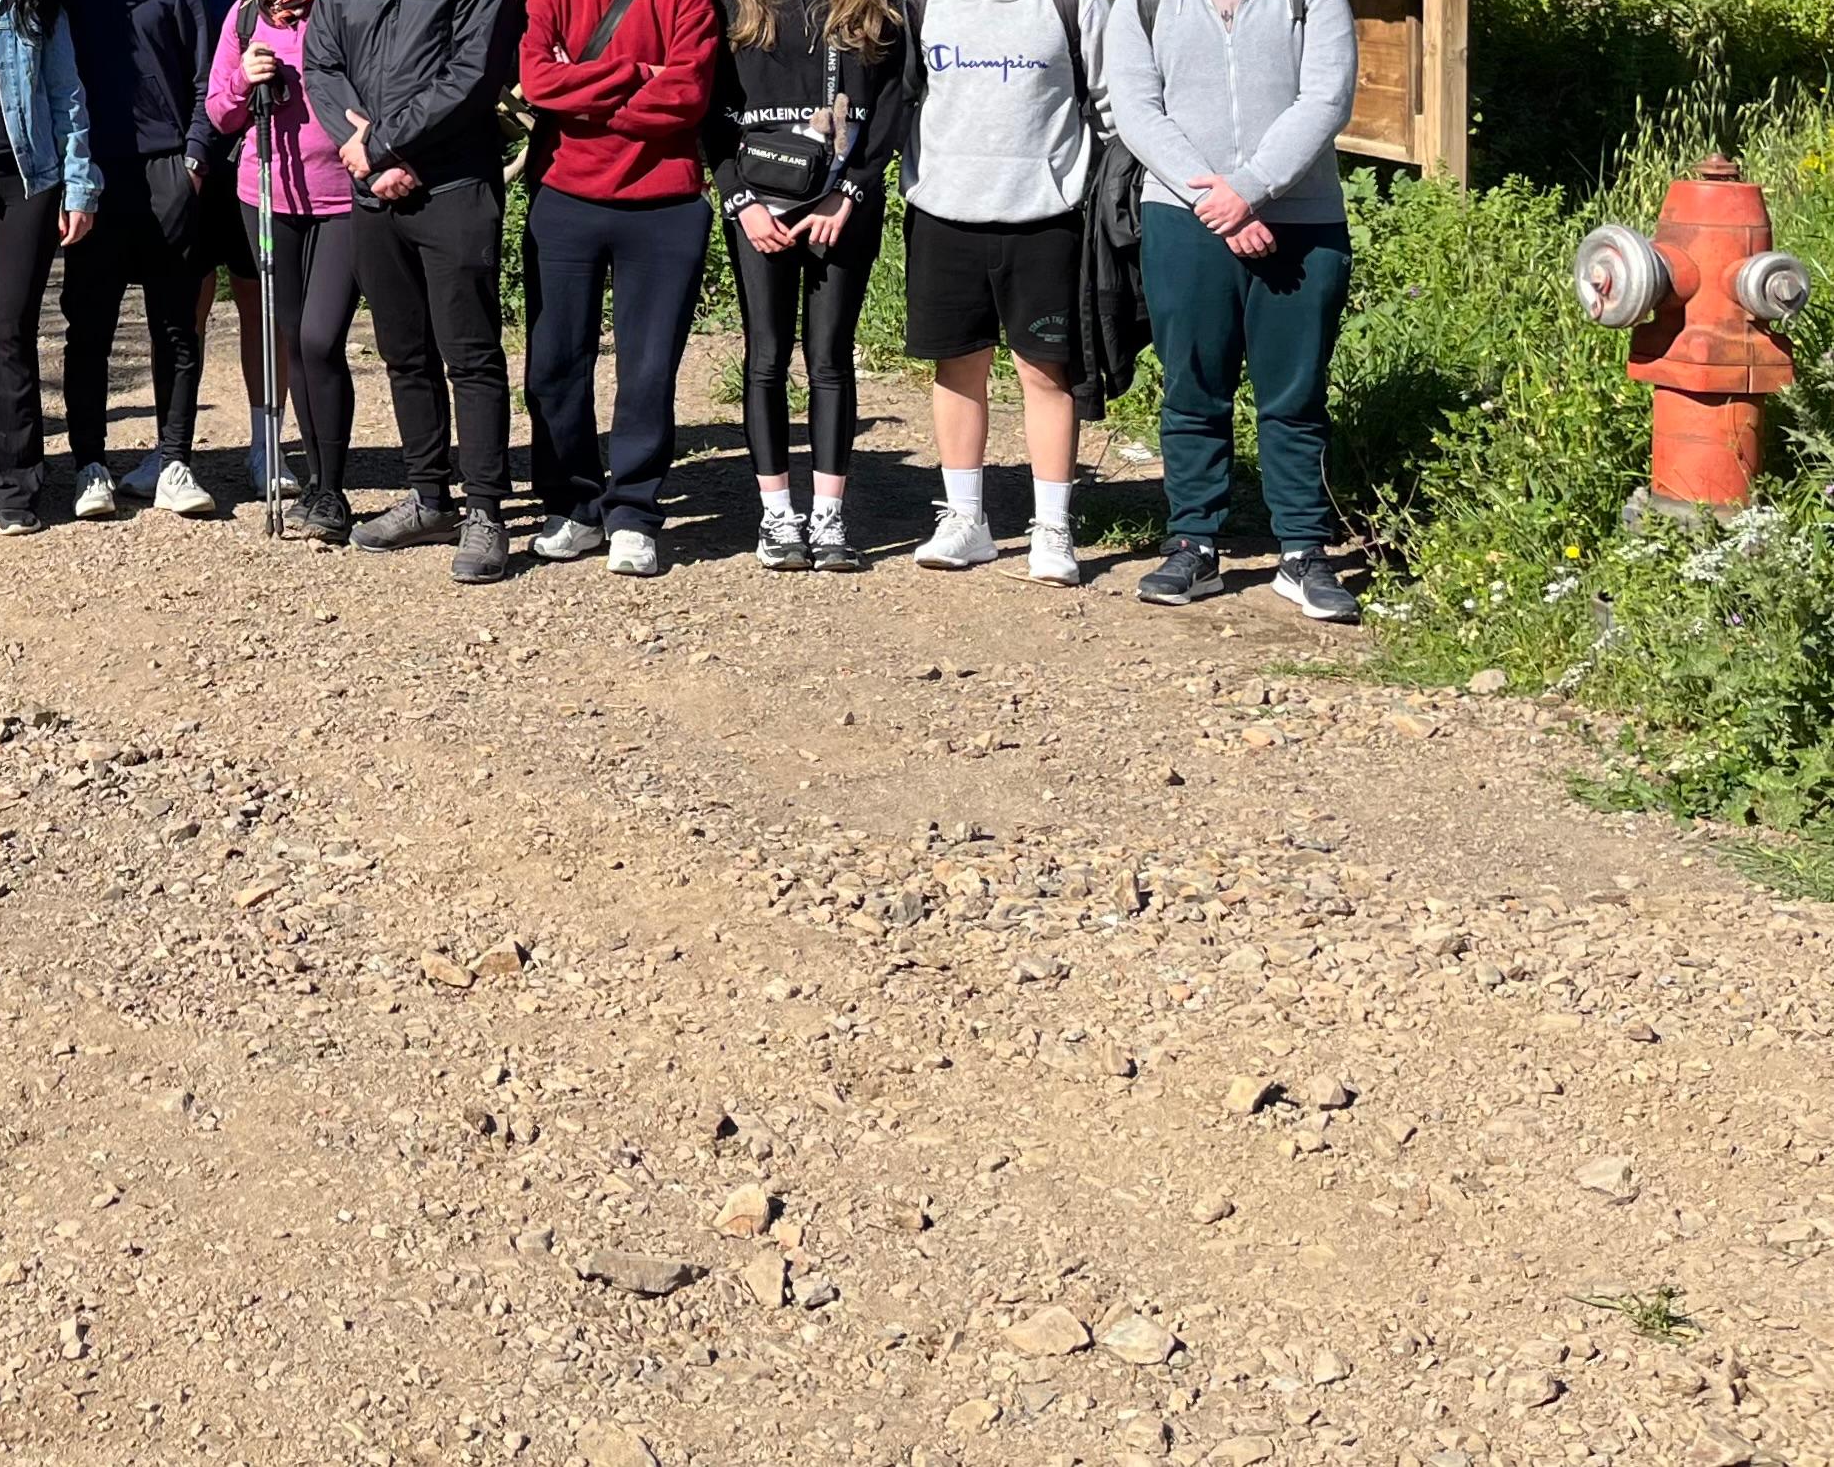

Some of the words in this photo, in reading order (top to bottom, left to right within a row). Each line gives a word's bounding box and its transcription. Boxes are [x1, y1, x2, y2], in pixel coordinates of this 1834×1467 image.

[928, 44, 1049, 83] Champion
[759, 107, 800, 122] KLEIN
[747, 147, 778, 161] TOMMY
[778, 155, 807, 167] JEANS
